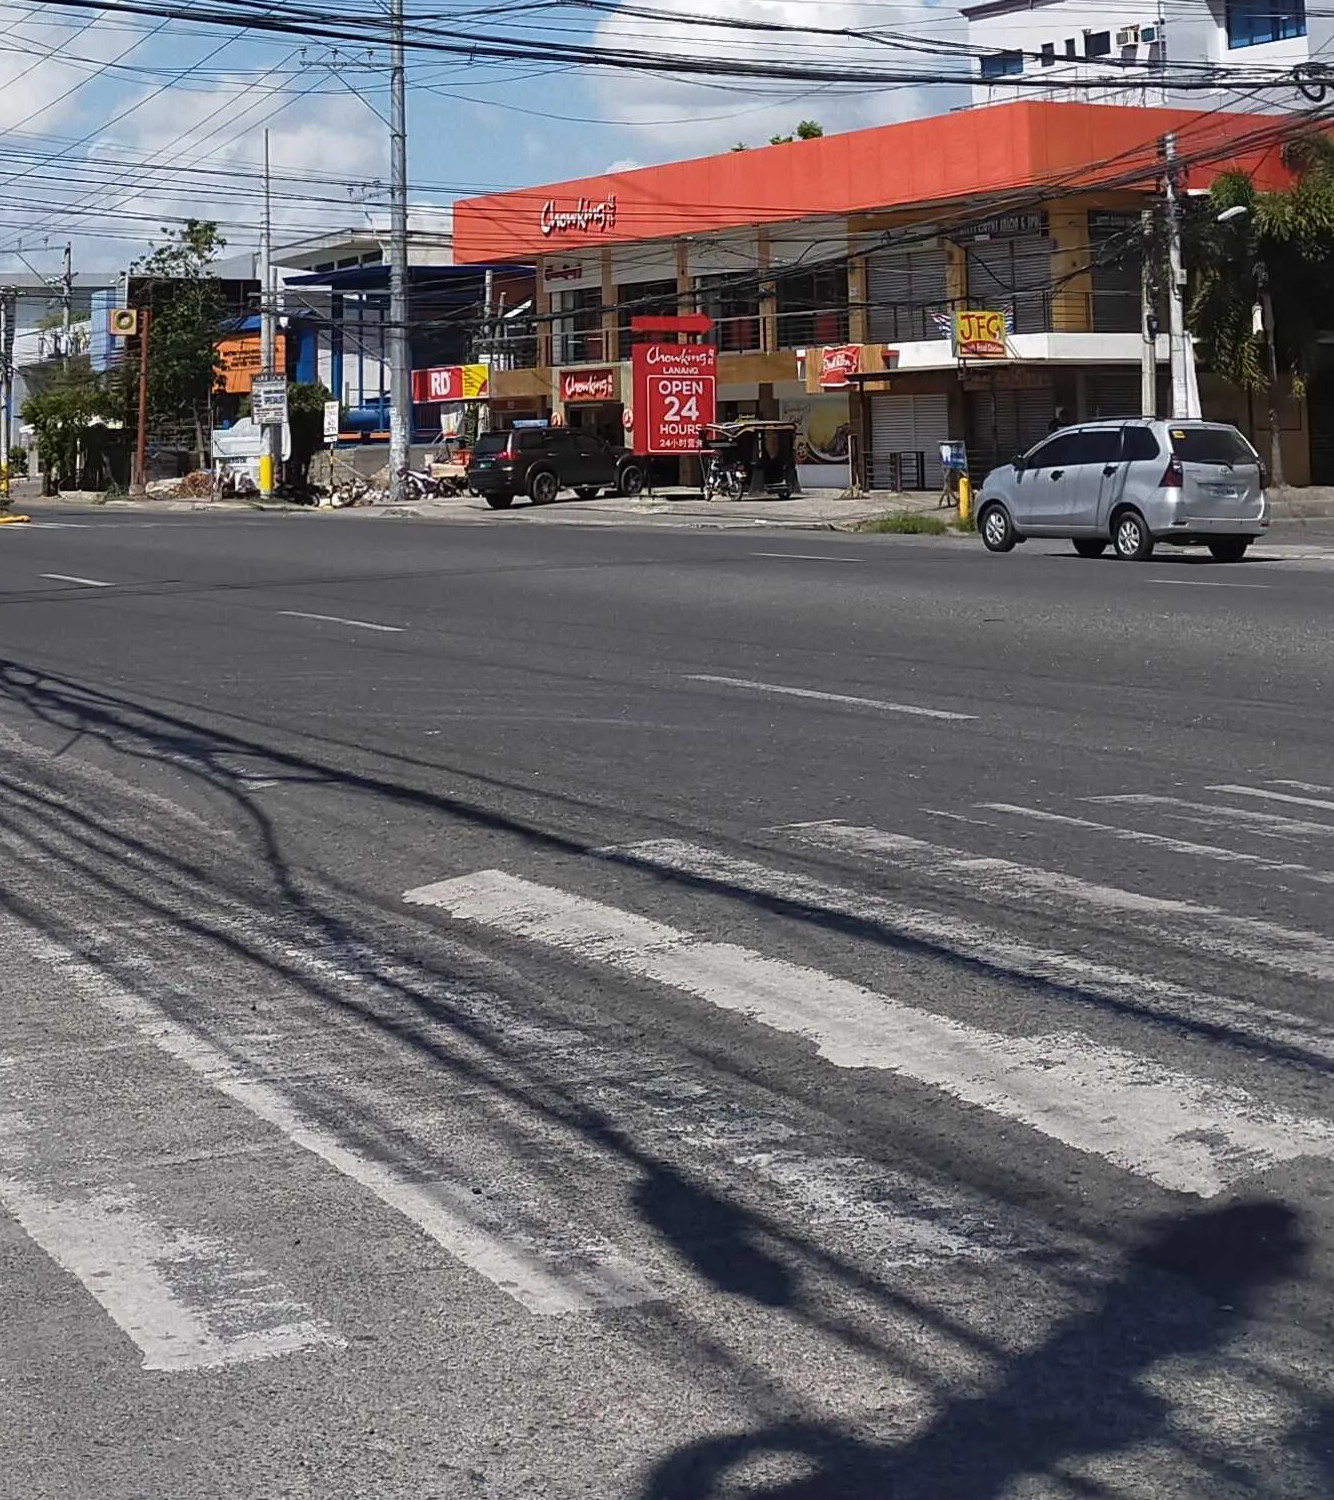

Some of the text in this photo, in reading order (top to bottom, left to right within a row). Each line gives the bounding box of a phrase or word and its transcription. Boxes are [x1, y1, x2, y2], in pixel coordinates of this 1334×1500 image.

[540, 196, 606, 234] Chowking
[961, 314, 1001, 341] JFC
[646, 346, 706, 366] Chowking
[663, 366, 699, 375] LANANG
[565, 375, 607, 399] Chowking
[658, 380, 703, 395] OPEN
[664, 396, 699, 421] 24
[659, 423, 702, 435] HOURS
